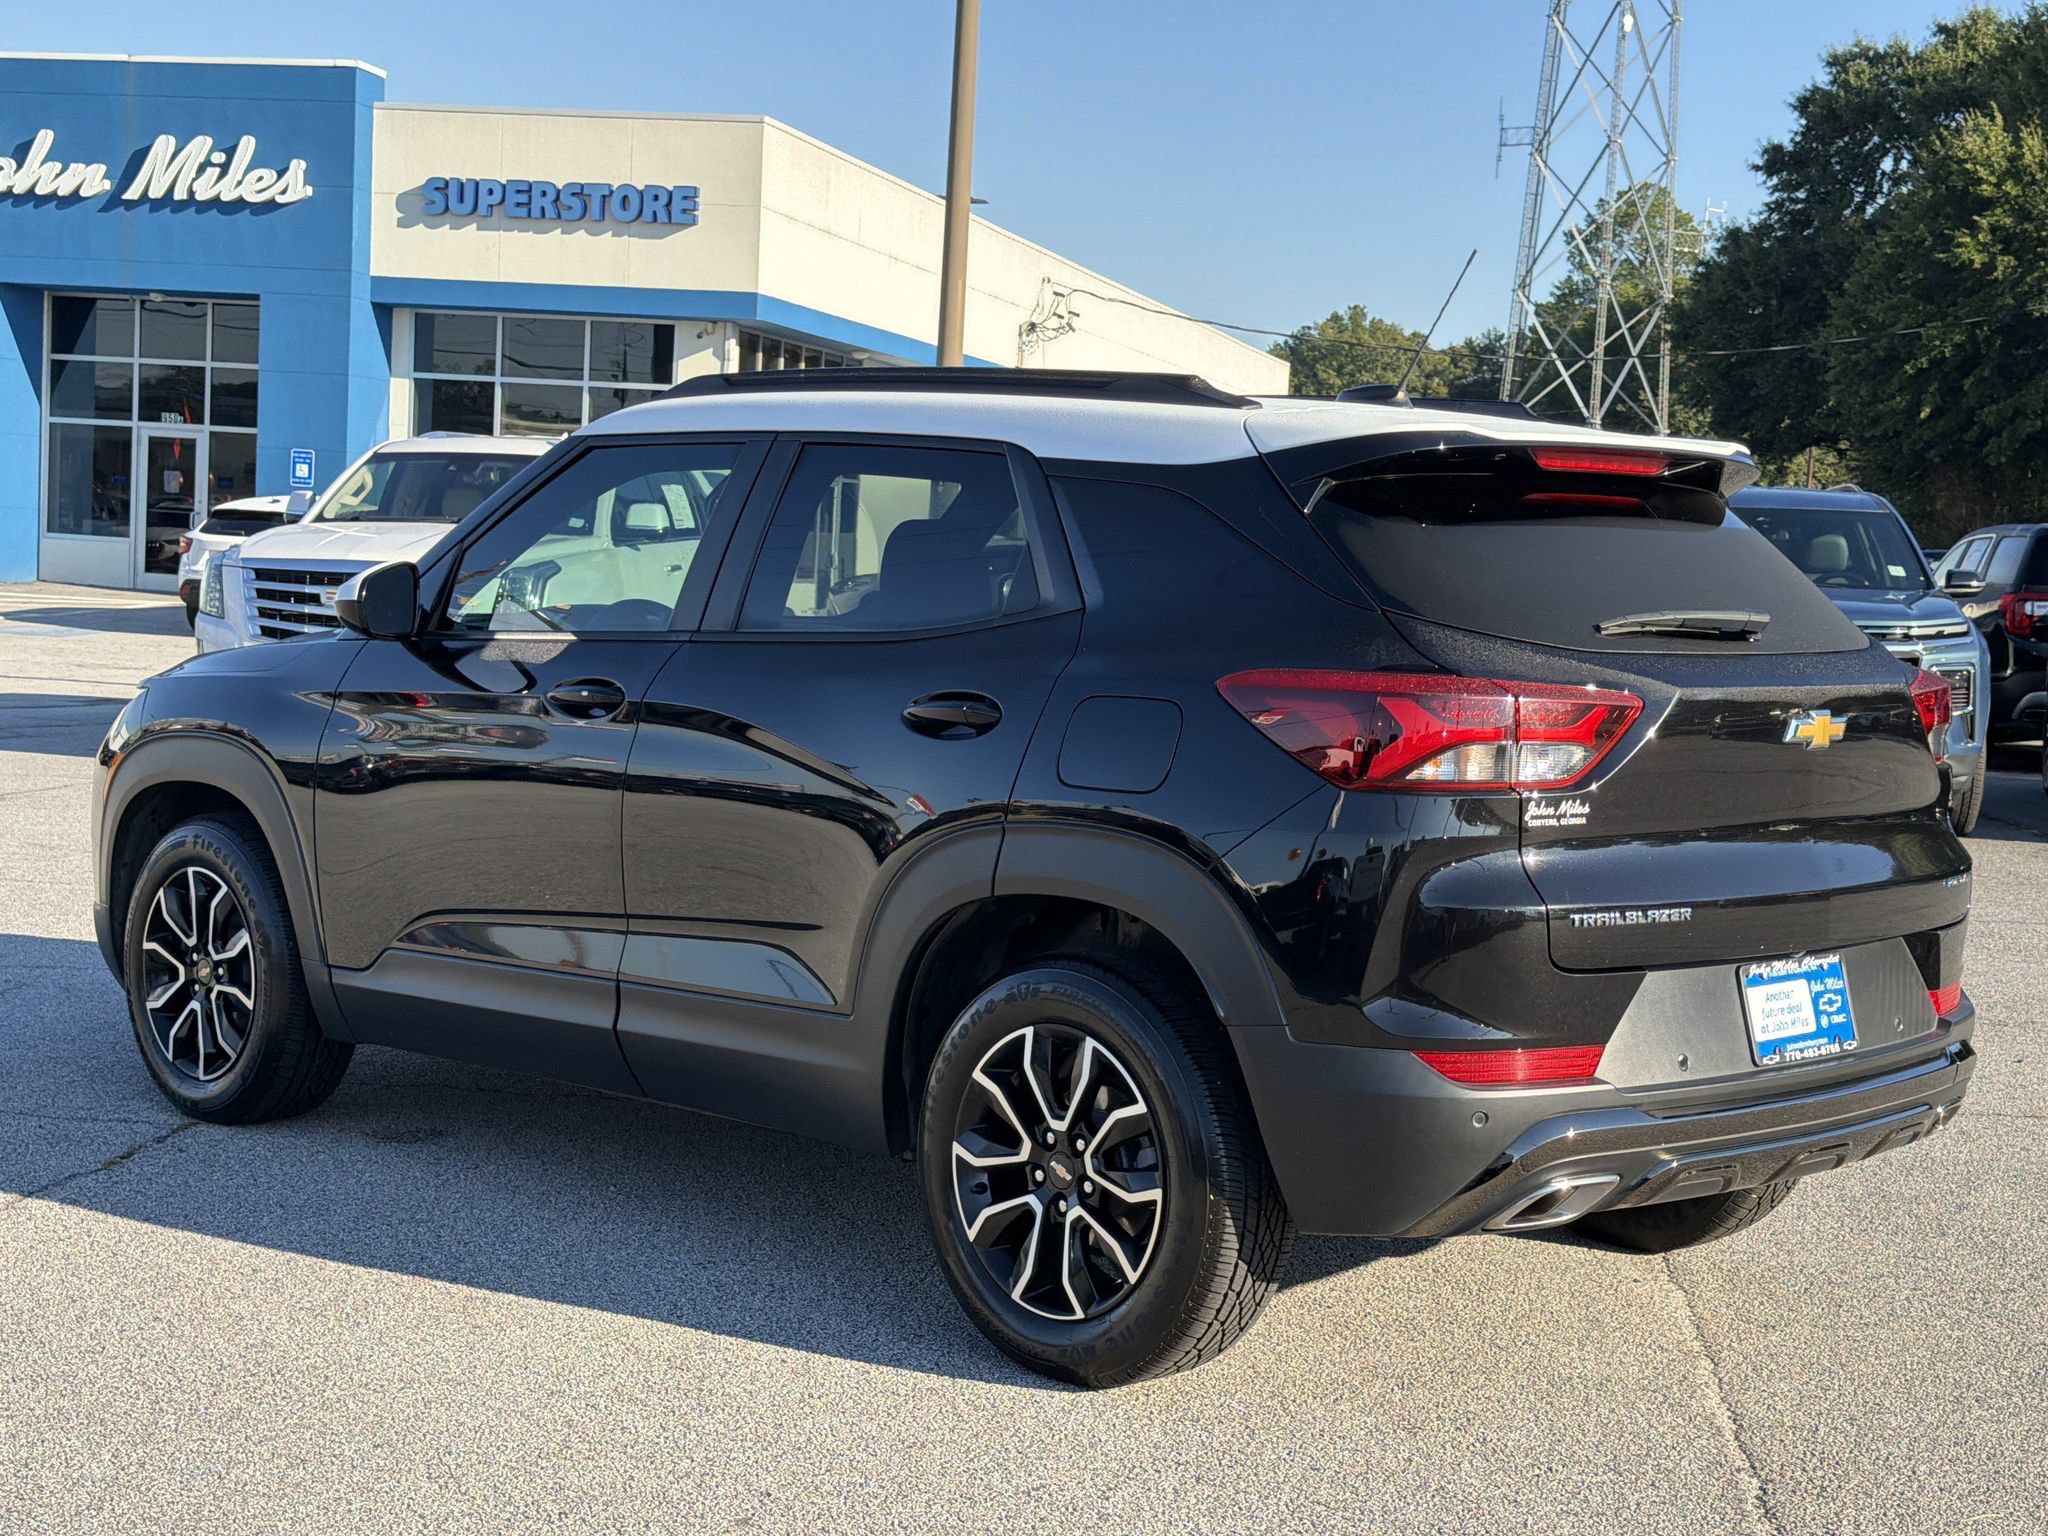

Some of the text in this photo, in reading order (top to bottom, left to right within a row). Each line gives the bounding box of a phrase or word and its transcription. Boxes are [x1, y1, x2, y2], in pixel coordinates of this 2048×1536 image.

[121, 134, 313, 204] Miles
[422, 176, 700, 225] SUPERSTORE
[1524, 799, 1591, 821] John Miles
[1569, 907, 1693, 928] TRAILBLAZER
